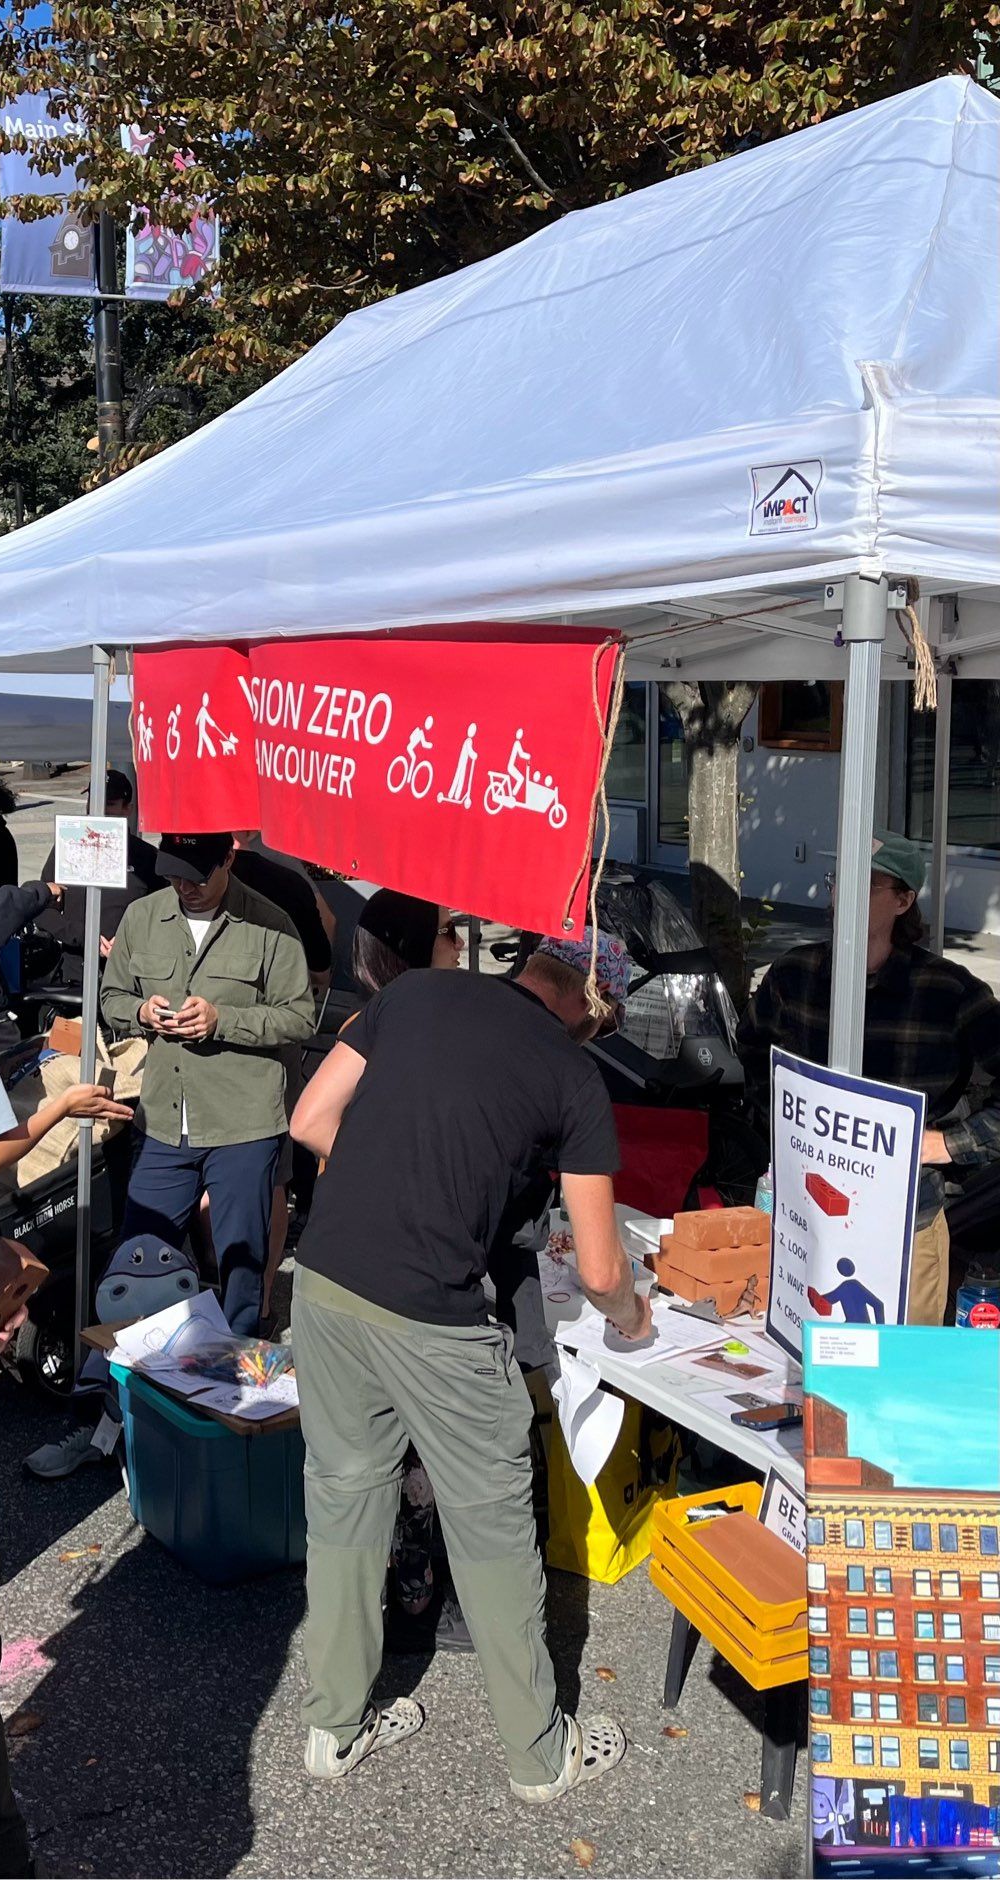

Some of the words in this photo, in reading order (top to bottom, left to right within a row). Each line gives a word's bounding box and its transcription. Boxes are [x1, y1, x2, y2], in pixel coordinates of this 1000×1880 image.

[5, 116, 57, 138] Main
[306, 684, 393, 745] ZERO
[782, 1090, 806, 1129] BE
[813, 1105, 897, 1158] SEEN
[790, 1135, 814, 1158] GRAB
[816, 1151, 824, 1164] A
[828, 1153, 875, 1179] BRICK!
[13, 1219, 35, 1239] BLACK
[36, 1207, 54, 1226] IRON
[54, 1195, 75, 1215] HORSE
[781, 1202, 787, 1216] 1.
[789, 1209, 808, 1232] GRAB
[779, 1232, 786, 1247] 2.
[788, 1238, 808, 1264] LOOK
[778, 1265, 785, 1280] 3.
[787, 1271, 804, 1297] WAVE
[776, 1296, 782, 1311] 4.
[784, 1304, 803, 1329] CROS
[778, 1494, 799, 1528] BE
[781, 1526, 801, 1550] GRAB
